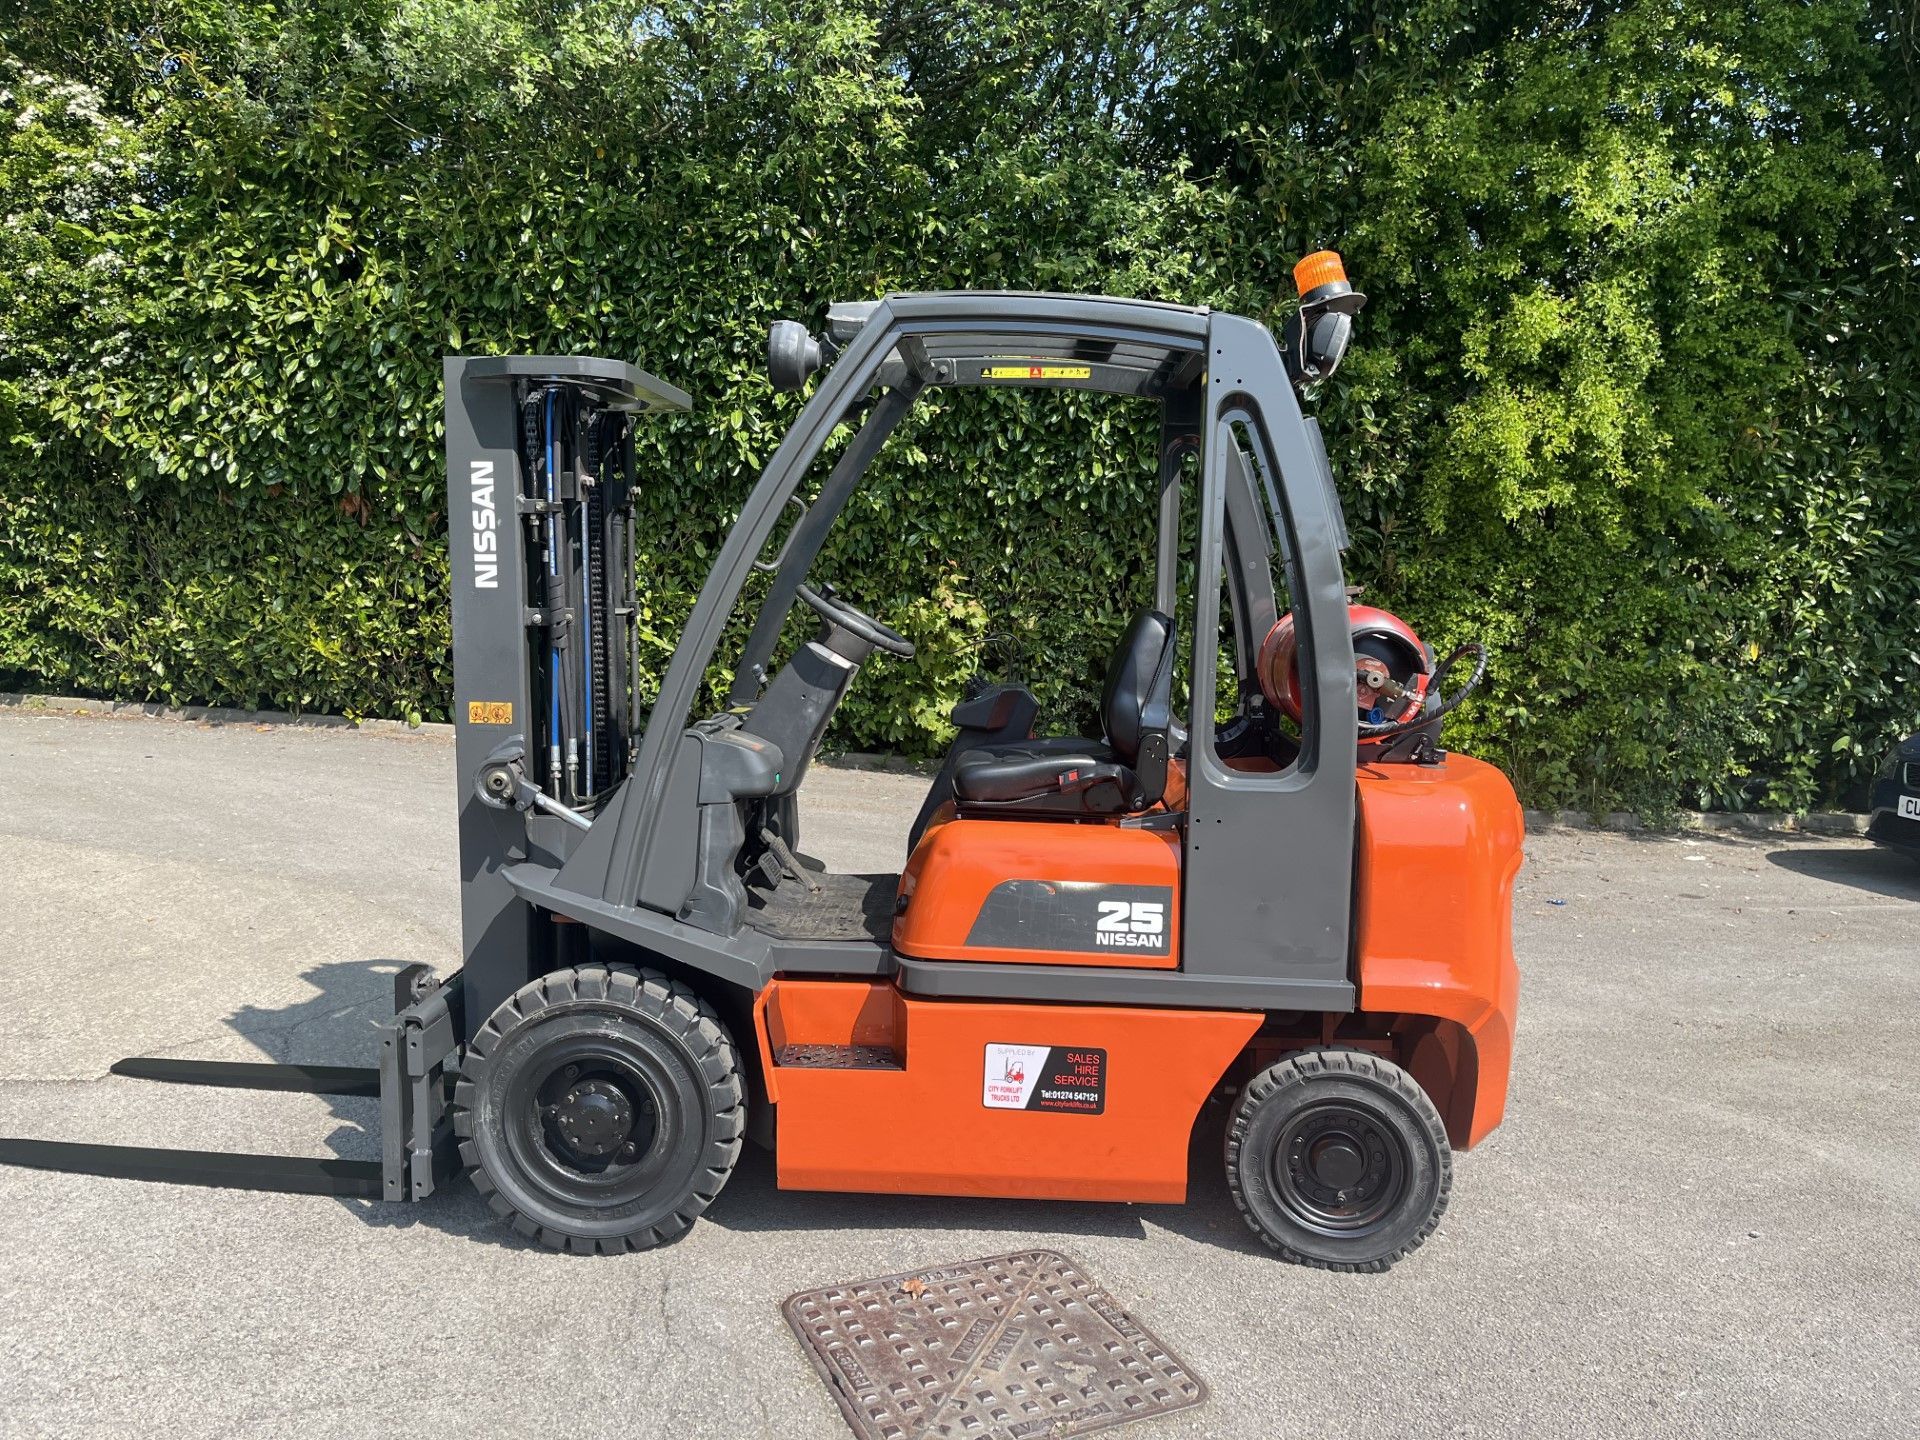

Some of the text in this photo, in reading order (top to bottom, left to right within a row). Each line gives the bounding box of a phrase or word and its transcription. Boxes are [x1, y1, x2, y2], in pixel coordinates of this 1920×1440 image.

[470, 461, 498, 588] NISSAN
[1097, 901, 1163, 933] 25
[1096, 932, 1162, 947] NISSAN
[997, 1048, 1026, 1056] SUPPLIED
[1067, 1053, 1100, 1064] SALES
[1075, 1065, 1099, 1075] HIRE
[1054, 1075, 1098, 1087] SERVICE
[1000, 1086, 1023, 1094] FORKLIFT
[991, 1094, 1020, 1103] TRUCKS LTD
[1041, 1090, 1098, 1102] Tel:01274 547121
[1041, 1100, 1097, 1109] www.cityforklifts.co.uk
